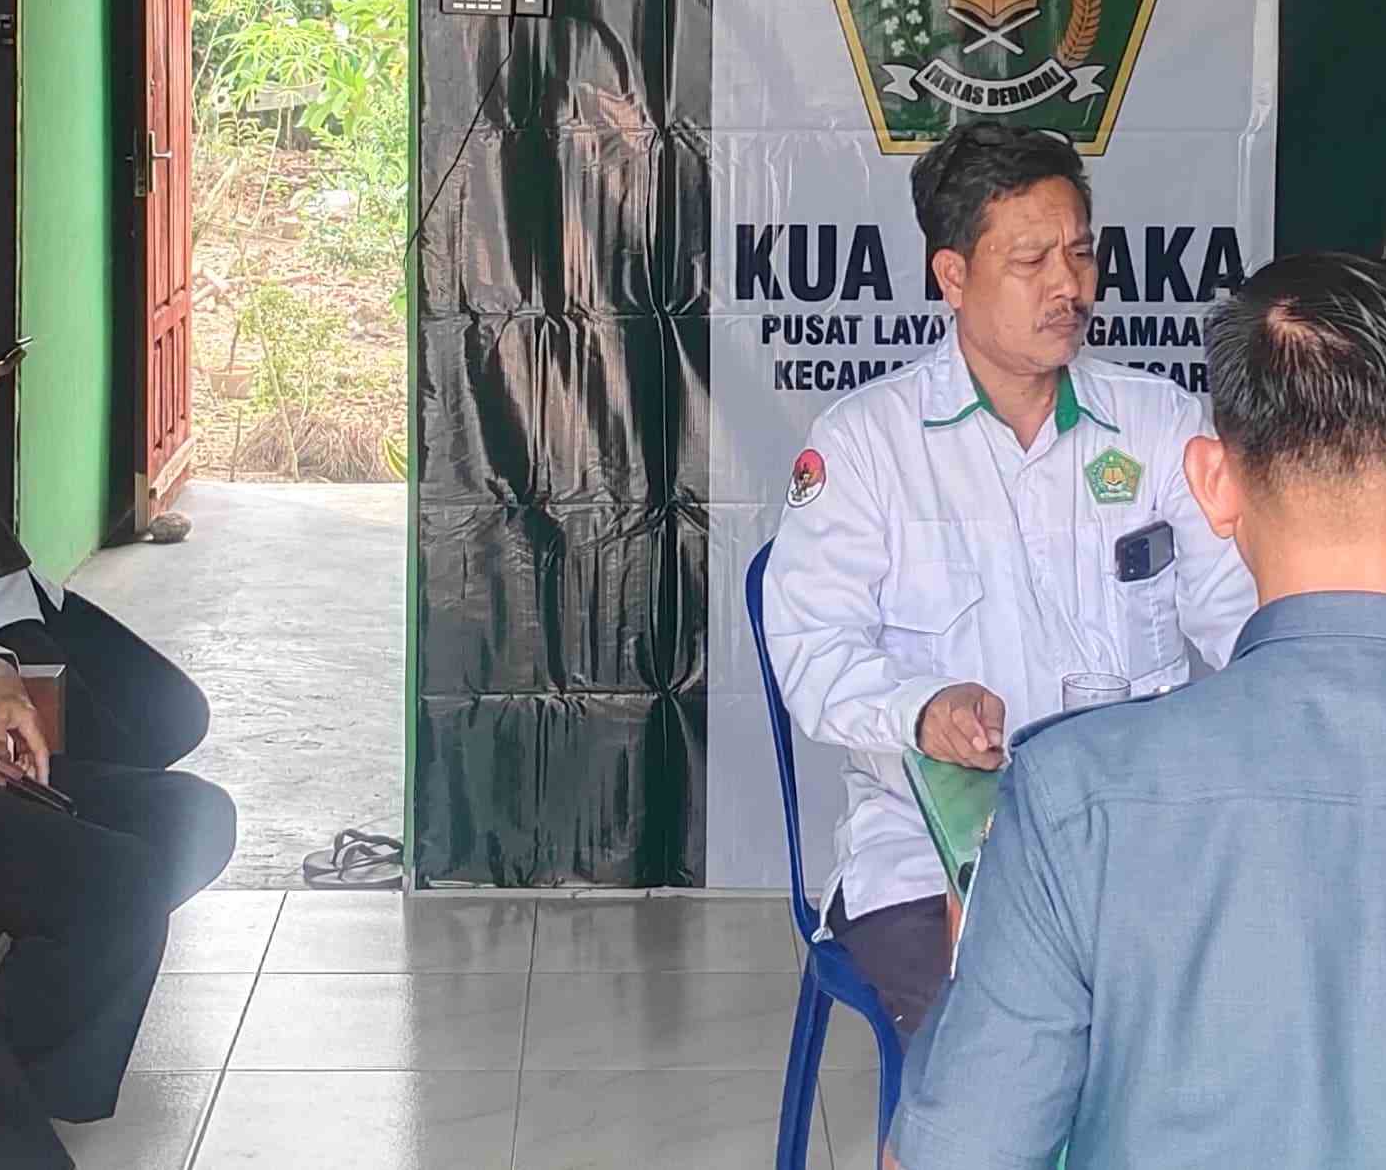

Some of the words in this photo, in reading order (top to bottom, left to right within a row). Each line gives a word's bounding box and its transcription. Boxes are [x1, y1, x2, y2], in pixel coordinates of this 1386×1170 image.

[986, 66, 1065, 107] BERAMAL
[734, 223, 894, 303] KUA
[761, 314, 864, 346] PUSAT
[874, 315, 954, 346] LAYA
[774, 360, 912, 392] KECAM
